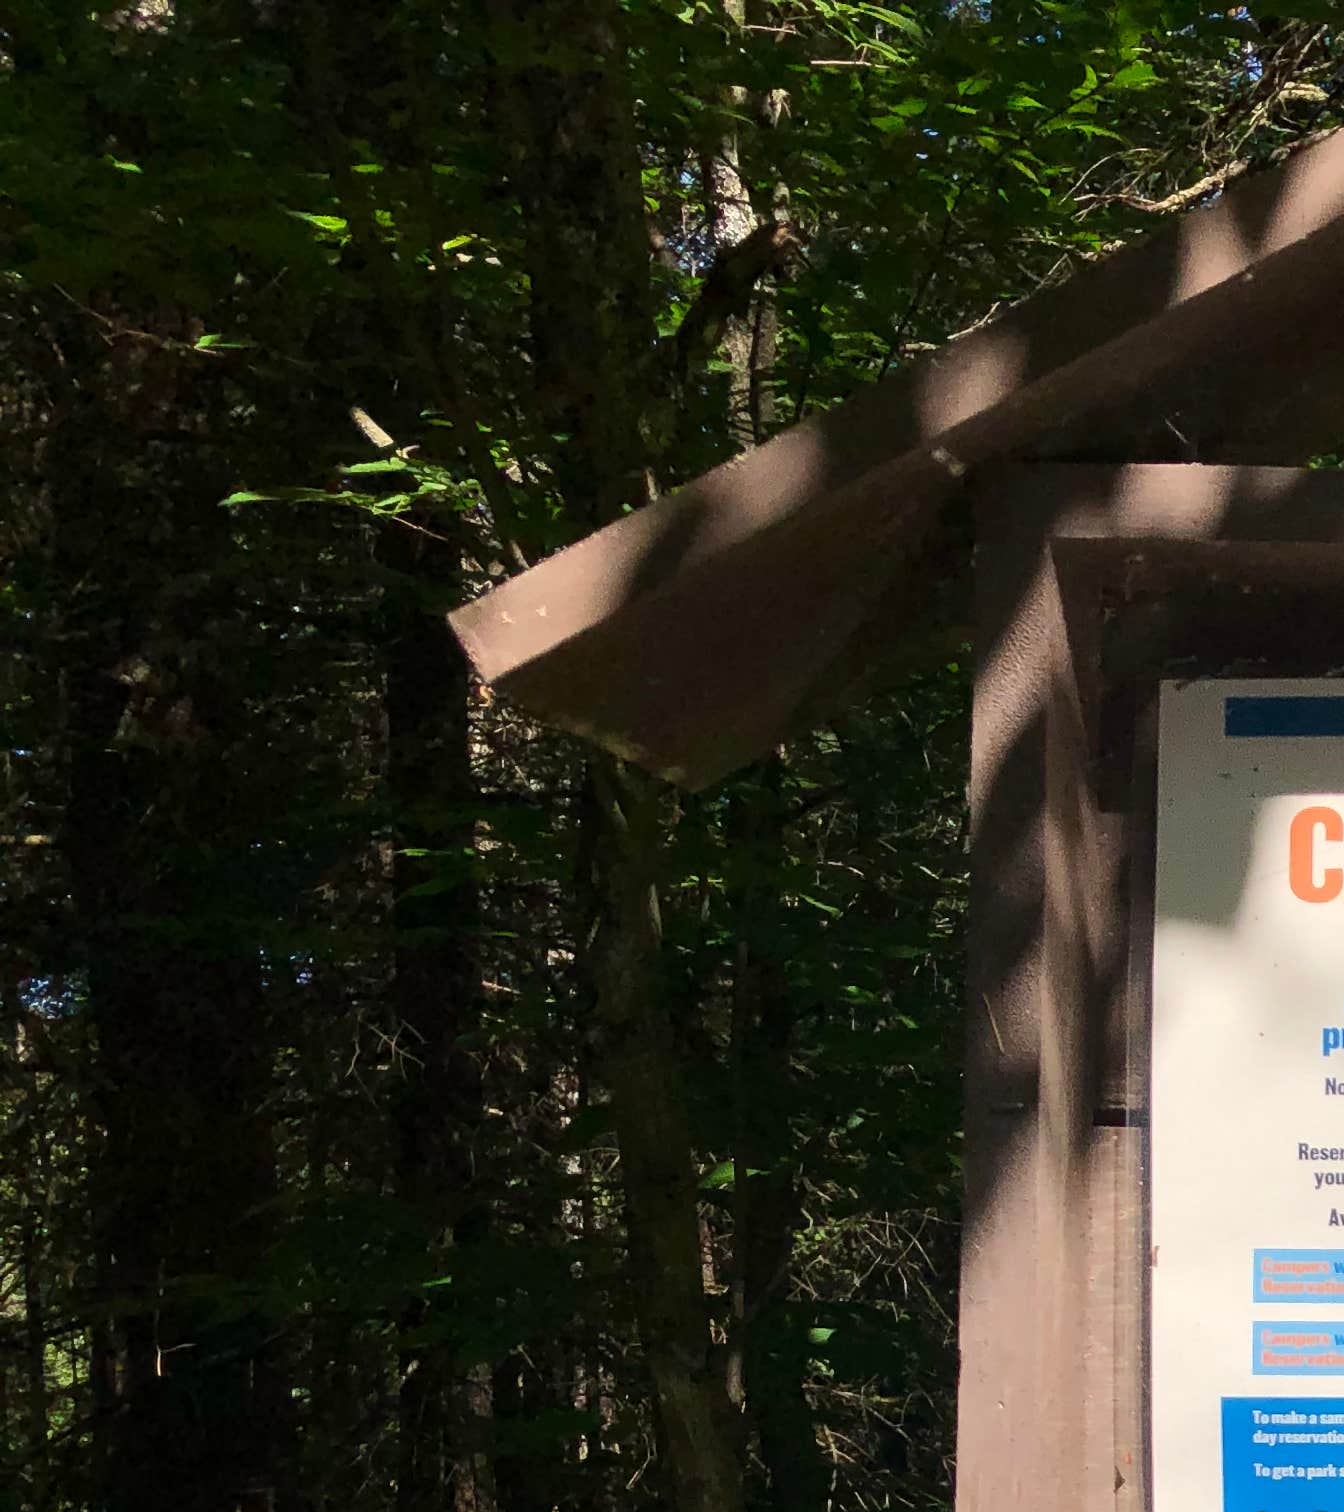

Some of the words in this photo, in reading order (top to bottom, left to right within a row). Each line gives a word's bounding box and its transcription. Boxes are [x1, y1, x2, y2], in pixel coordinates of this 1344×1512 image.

[1254, 1463, 1270, 1476] To
[1272, 1465, 1295, 1480] get
[1297, 1467, 1305, 1477] a
[1307, 1464, 1336, 1480] park
